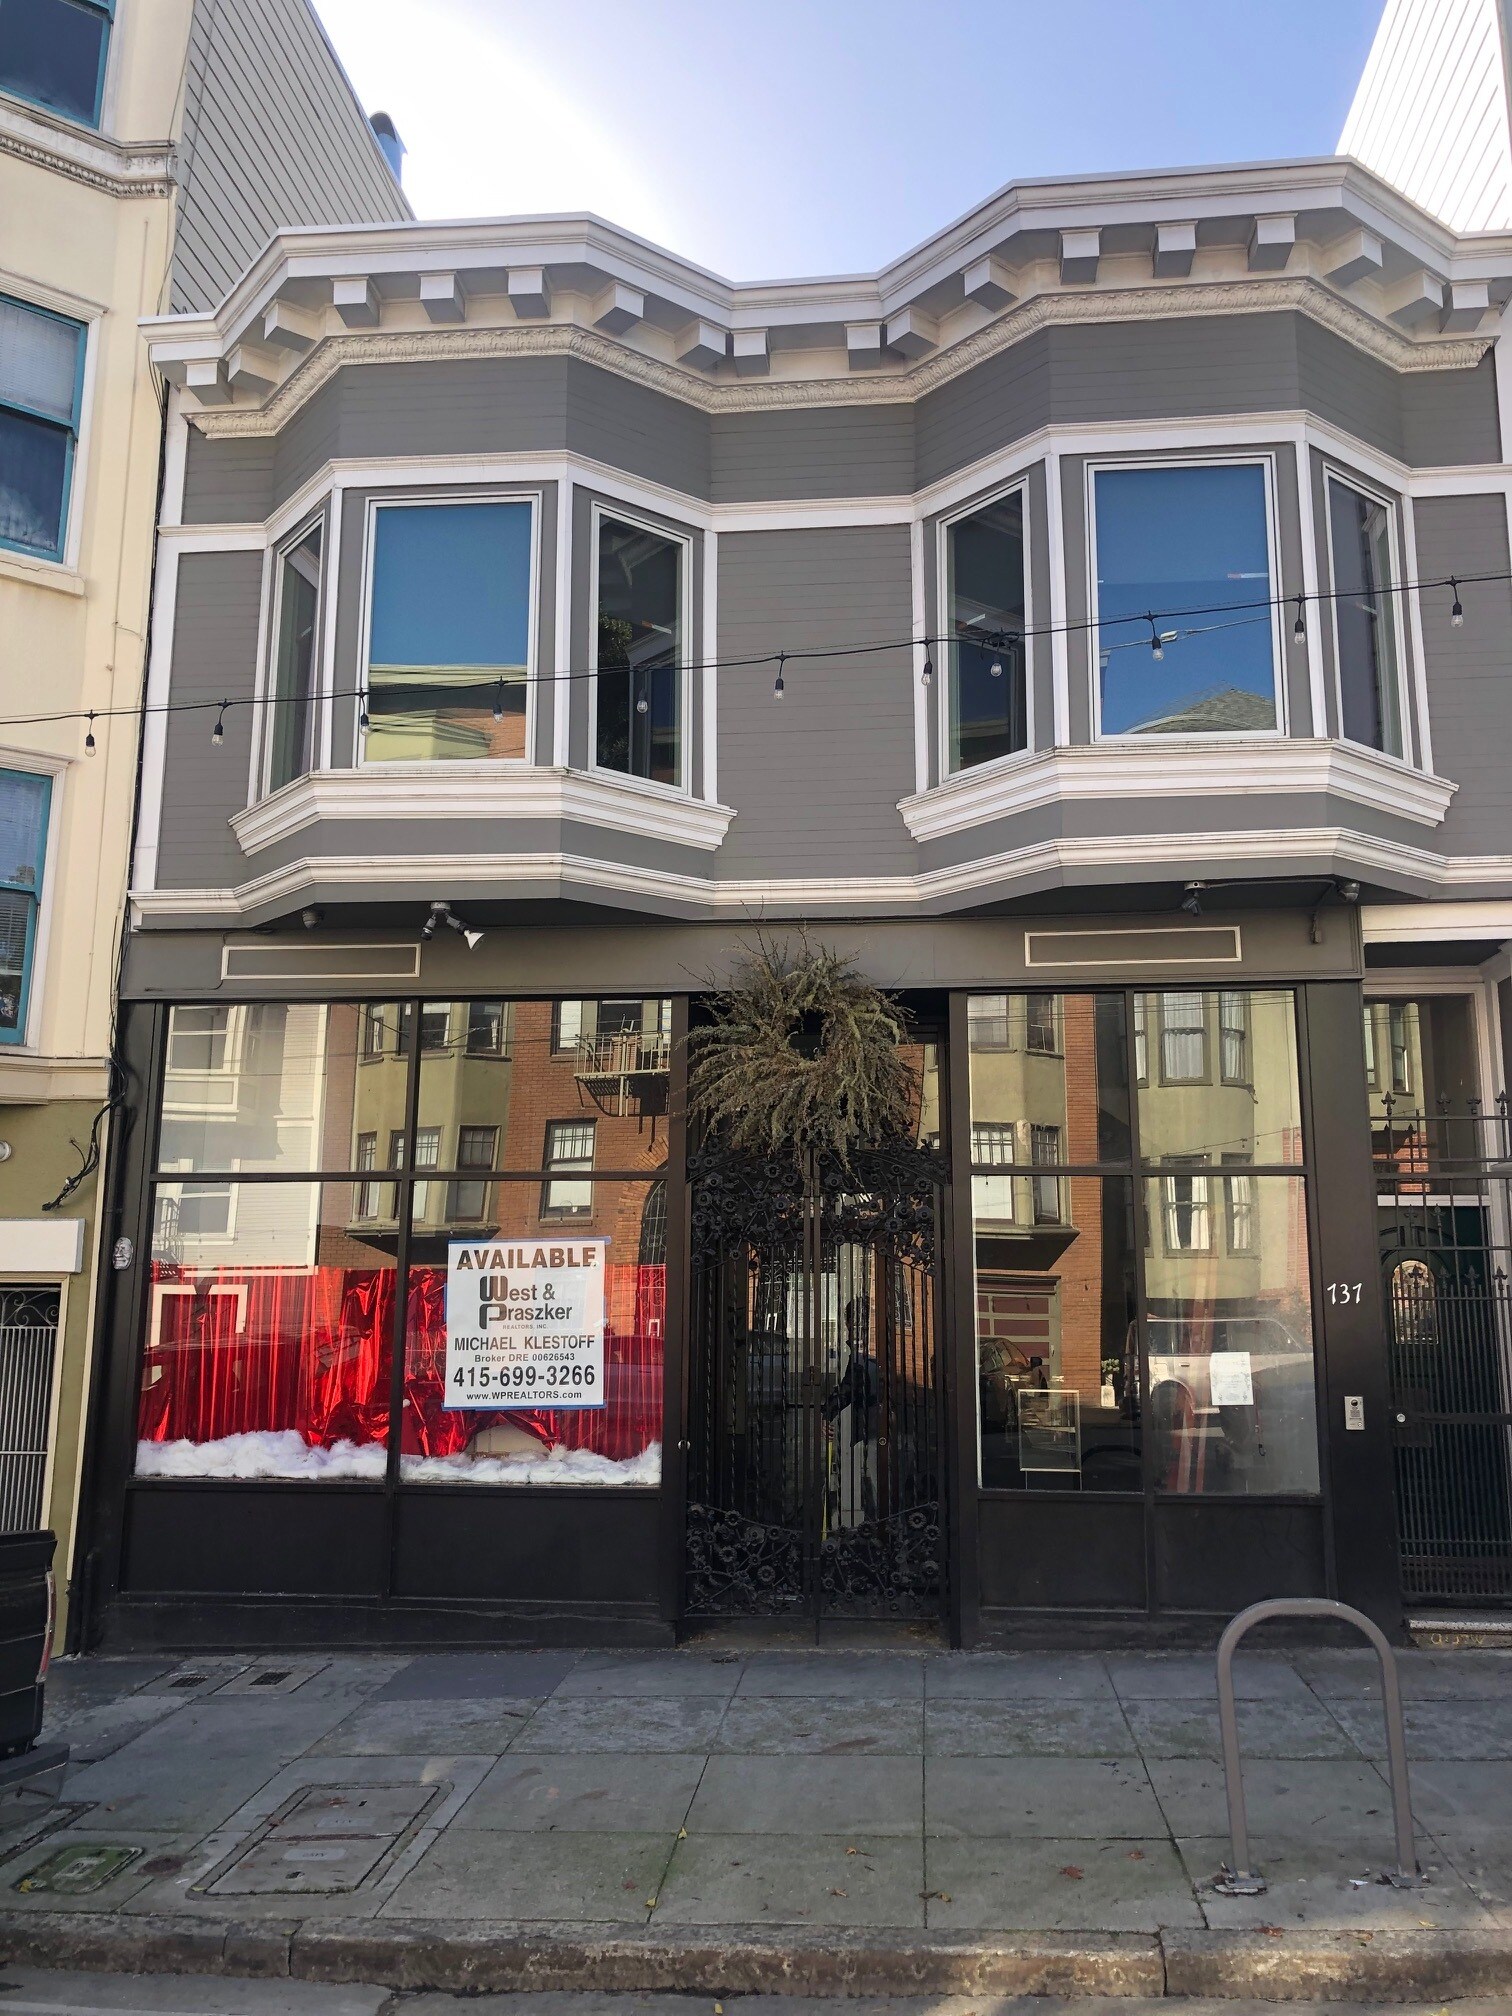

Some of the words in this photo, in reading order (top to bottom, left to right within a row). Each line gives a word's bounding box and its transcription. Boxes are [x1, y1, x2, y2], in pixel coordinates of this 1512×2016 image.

[456, 1246, 597, 1270] AVAILABLE
[479, 1275, 537, 1302] West
[542, 1282, 556, 1301] &
[1326, 1282, 1363, 1305] 131
[478, 1303, 573, 1330] Praszker
[454, 1336, 518, 1351] MICHAEL
[524, 1334, 596, 1350] KLESTOFF
[474, 1354, 506, 1363] Broker
[508, 1353, 529, 1362] DRE
[532, 1352, 575, 1362] 00626543
[453, 1364, 596, 1388] 415-699-3266
[466, 1390, 582, 1400] www.WPREALTORS.com
